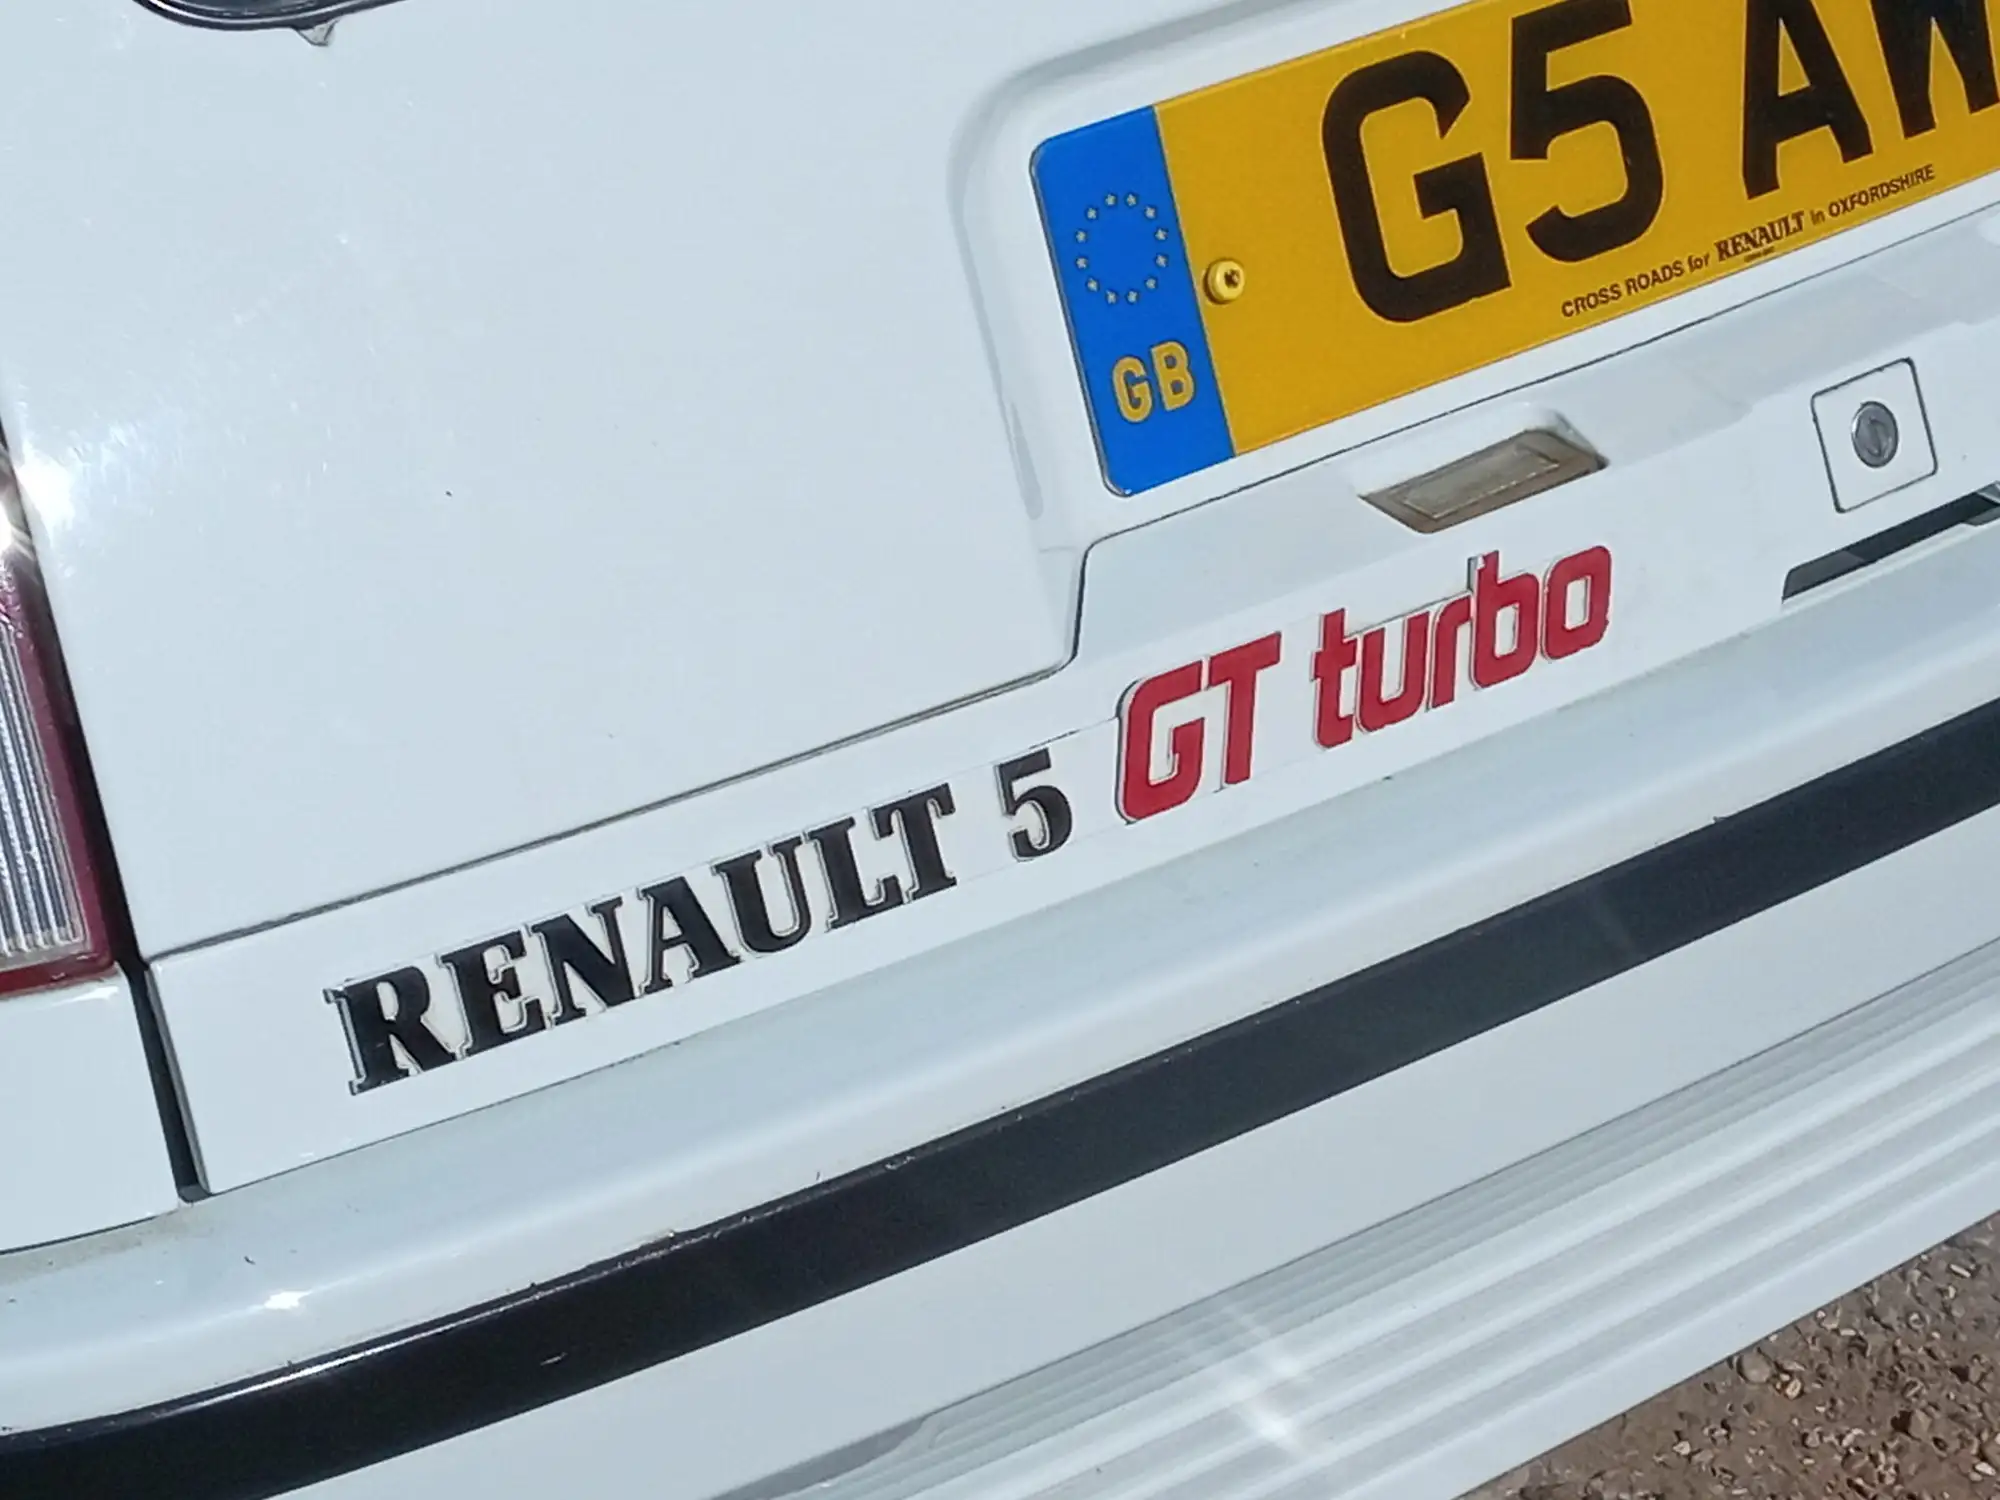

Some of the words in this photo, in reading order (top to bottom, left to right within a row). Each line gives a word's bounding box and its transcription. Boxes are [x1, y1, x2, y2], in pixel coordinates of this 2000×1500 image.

[1322, 0, 1664, 323] G5
[1561, 283, 1622, 317] CROSS
[1625, 260, 1685, 295] ROADS
[1688, 252, 1711, 273] for
[1713, 210, 1804, 262] RENAULT
[1810, 209, 1826, 226] in
[1828, 163, 1936, 218] OXFORDSHIRE
[1113, 341, 1195, 422] GB
[323, 783, 957, 1094] RENAULT
[995, 748, 1073, 862] 5
[1115, 630, 1282, 824] GT
[1310, 545, 1613, 750] turbo
